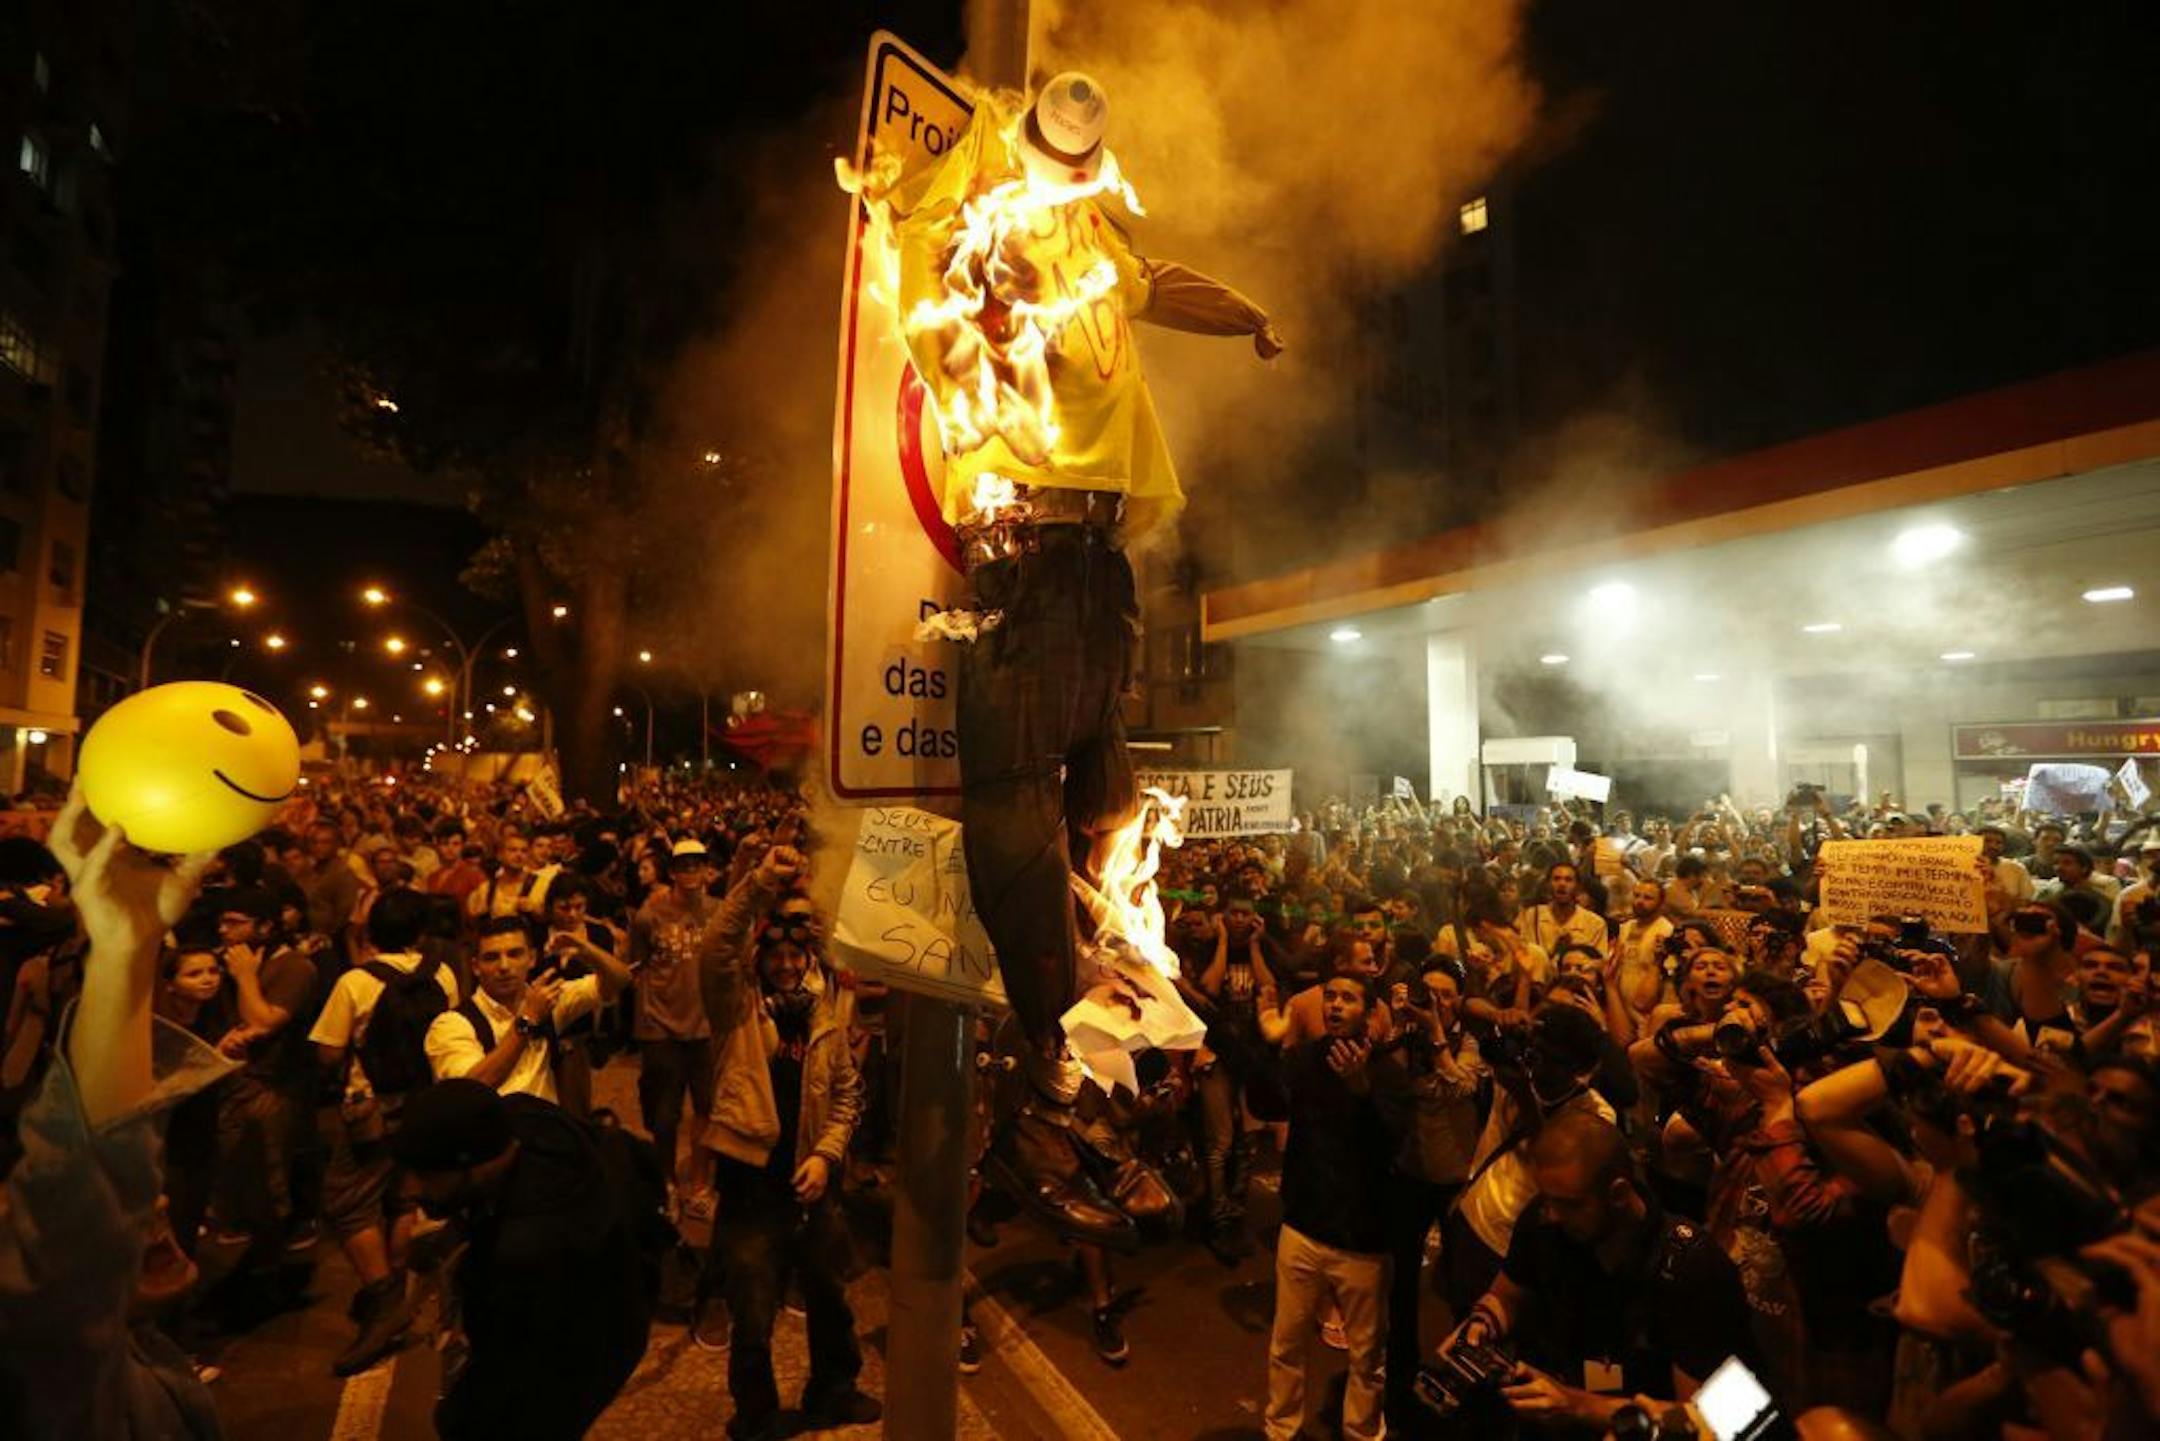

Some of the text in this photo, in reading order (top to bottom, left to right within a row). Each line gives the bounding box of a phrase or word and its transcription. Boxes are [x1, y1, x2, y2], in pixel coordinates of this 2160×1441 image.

[886, 84, 960, 156] Proi
[885, 657, 946, 699] das
[861, 717, 957, 759] e das
[1203, 774, 1216, 800] E
[1188, 806, 1243, 834] PATRIA
[867, 876, 915, 906] EU
